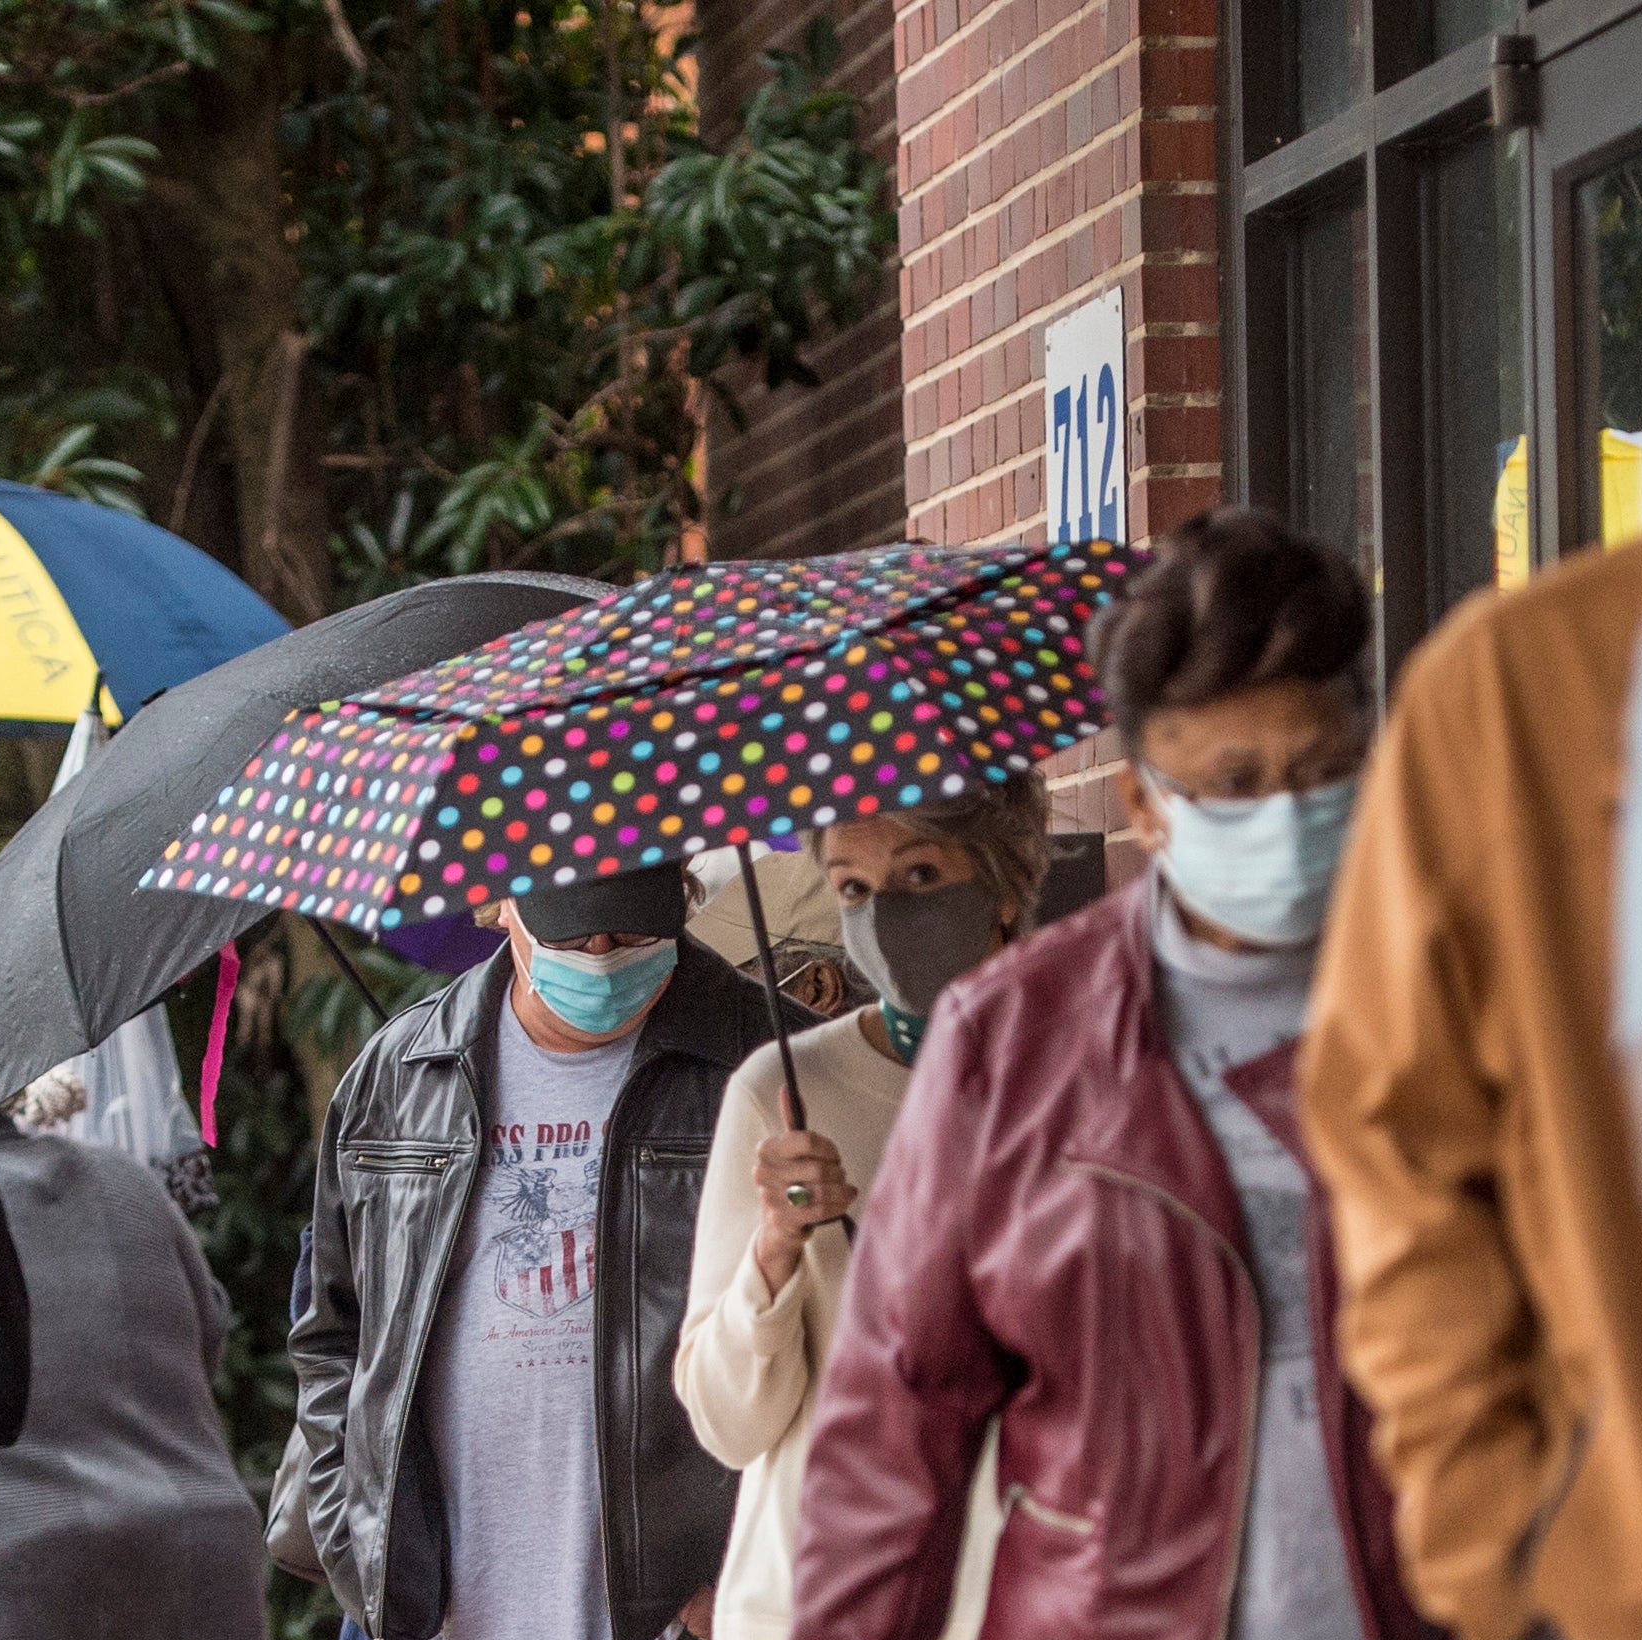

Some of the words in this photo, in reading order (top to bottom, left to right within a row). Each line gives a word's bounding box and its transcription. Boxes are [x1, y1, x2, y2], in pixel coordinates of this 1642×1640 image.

[1053, 362, 1118, 546] 712
[489, 1122, 525, 1165] SS
[534, 1120, 591, 1162] PRO
[504, 1323, 556, 1339] American
